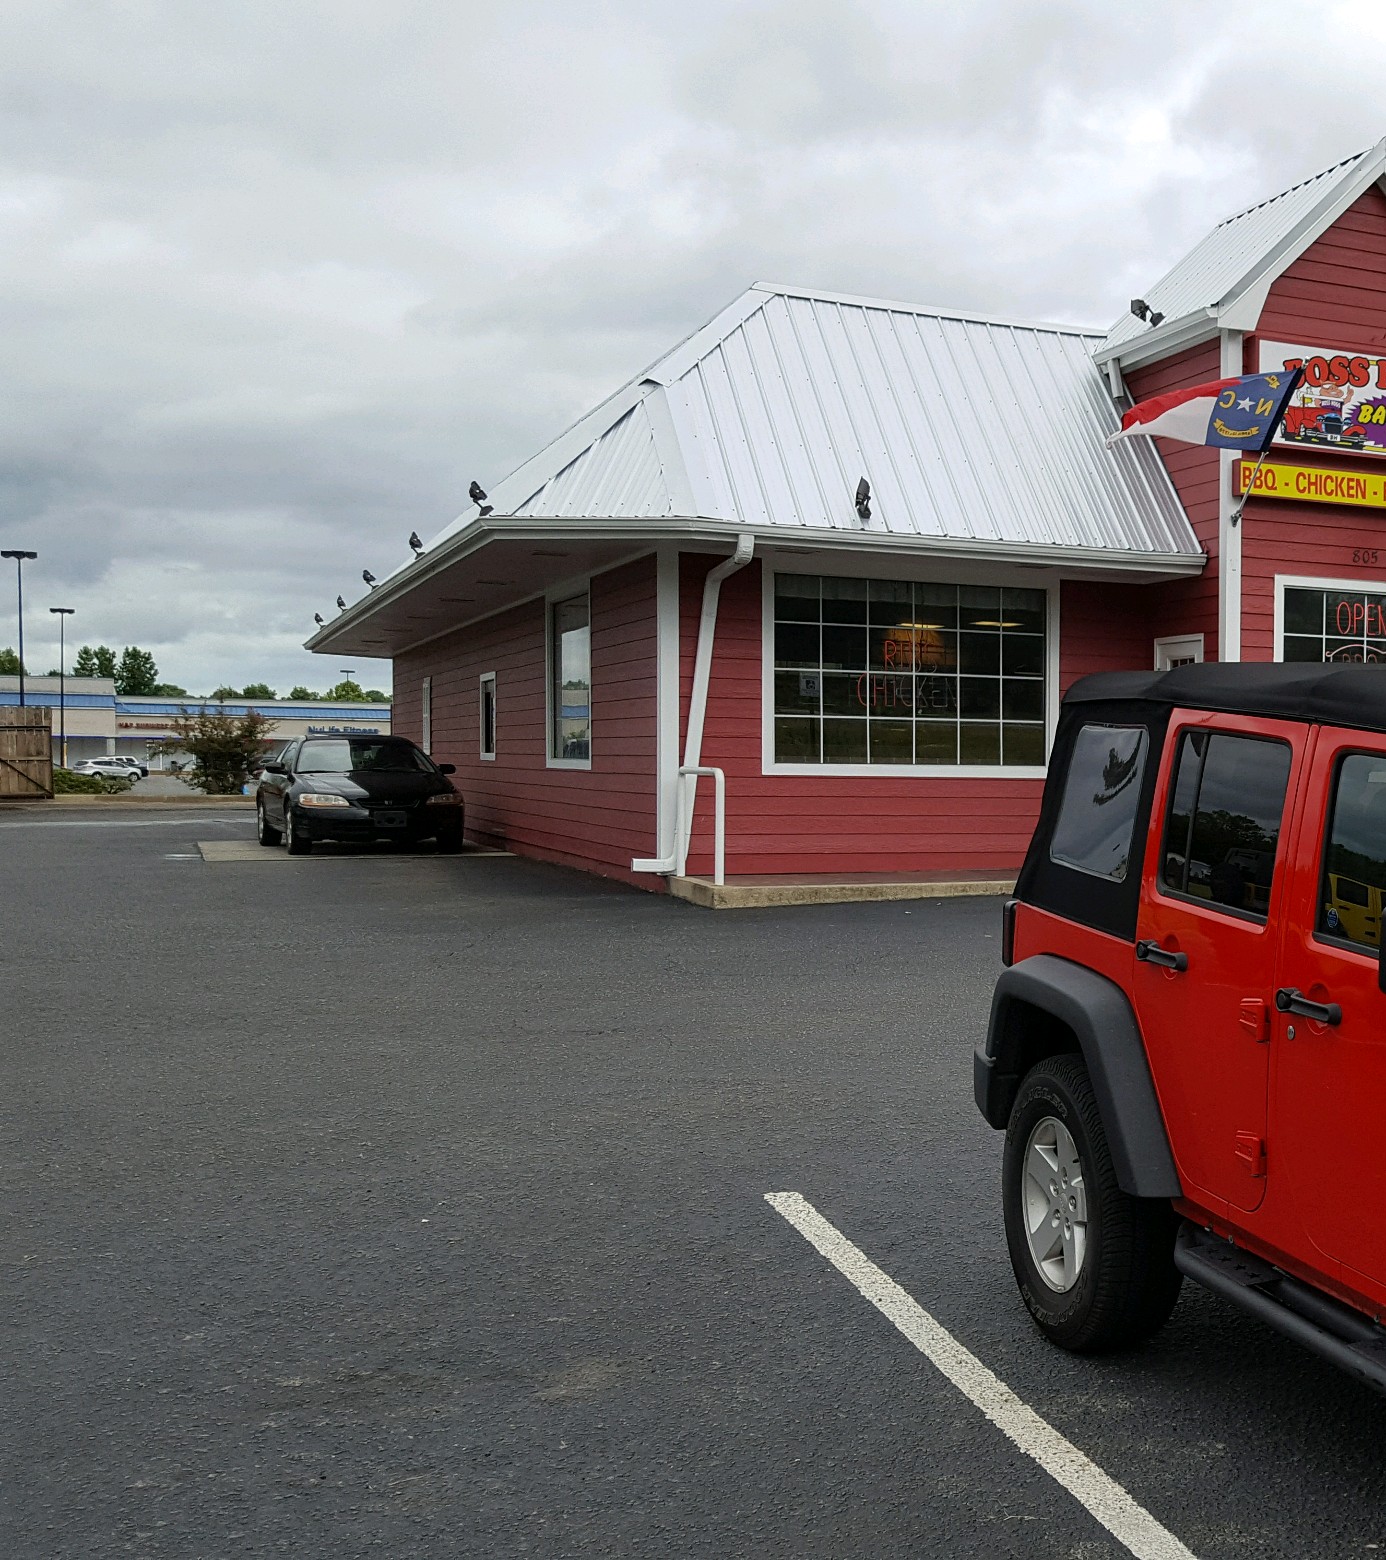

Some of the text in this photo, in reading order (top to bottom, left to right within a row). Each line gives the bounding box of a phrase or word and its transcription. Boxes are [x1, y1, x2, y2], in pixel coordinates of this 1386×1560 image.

[1242, 466, 1277, 491] BBQ
[1295, 471, 1367, 500] CHICKEN
[1352, 550, 1379, 564] 805
